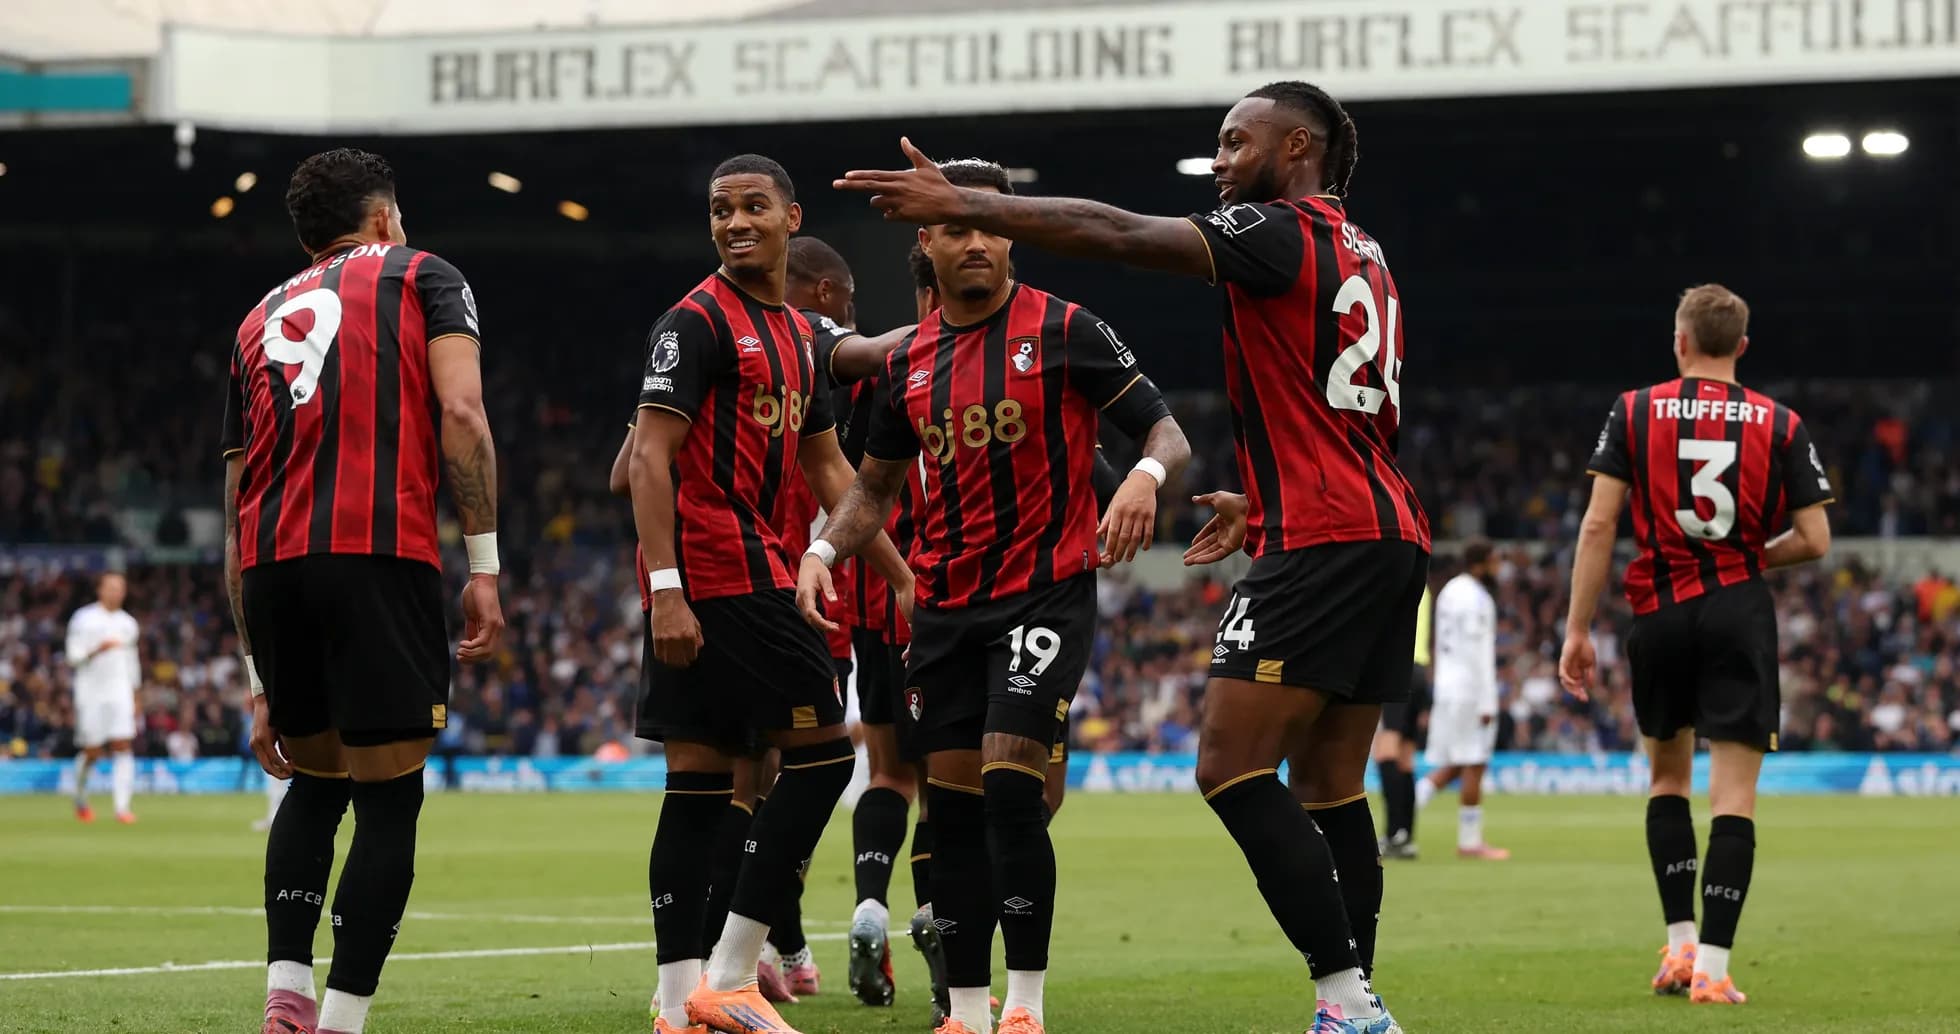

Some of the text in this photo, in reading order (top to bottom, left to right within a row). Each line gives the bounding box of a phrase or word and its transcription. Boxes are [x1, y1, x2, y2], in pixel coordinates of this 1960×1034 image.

[429, 44, 697, 103] BURFLEX
[733, 22, 1173, 96] SCAFFOLDING
[1227, 9, 1523, 74] BURFLEX
[261, 288, 342, 409] 9
[1653, 398, 1769, 425] TRUFFERT
[918, 399, 1026, 465] bj88
[1675, 438, 1737, 541] 3
[1008, 625, 1061, 676] 19
[1007, 686, 1032, 695] umbro
[856, 851, 890, 865] AFCB
[277, 888, 322, 906] AFCB
[1704, 884, 1741, 901] AFCB
